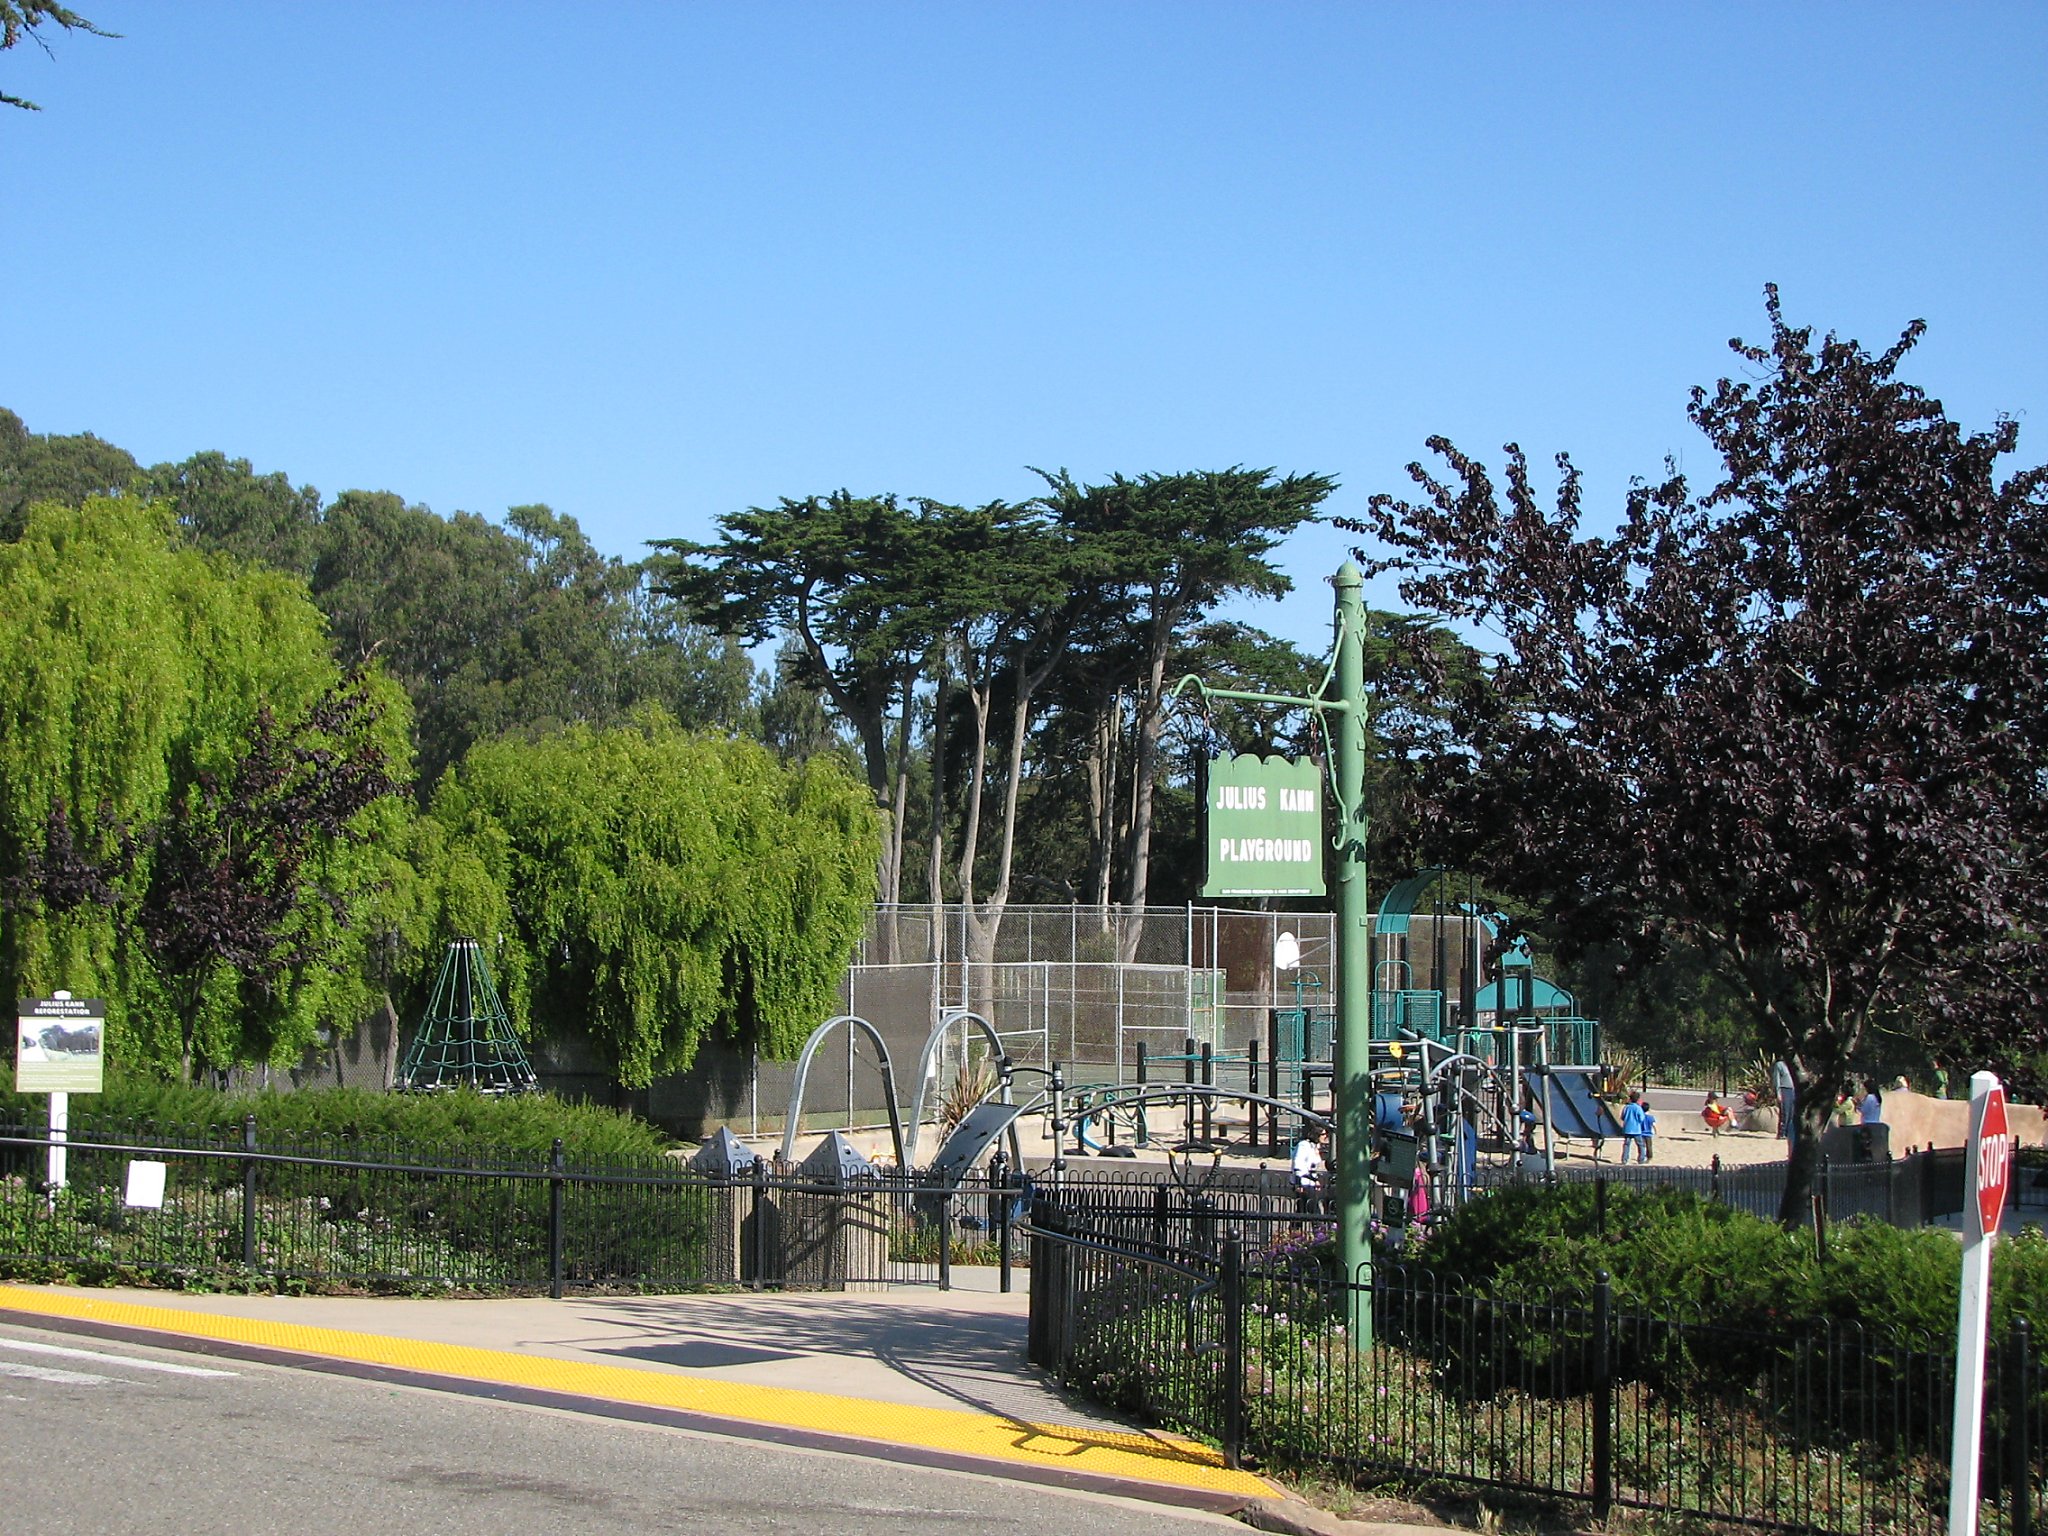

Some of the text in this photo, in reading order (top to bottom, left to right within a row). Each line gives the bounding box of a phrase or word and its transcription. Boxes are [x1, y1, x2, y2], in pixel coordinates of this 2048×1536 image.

[1216, 786, 1314, 812] JULIUS KAHN
[1220, 838, 1312, 862] PLAYGROUND
[40, 1000, 64, 1008] JULIUS
[1979, 1133, 2006, 1191] STOP
